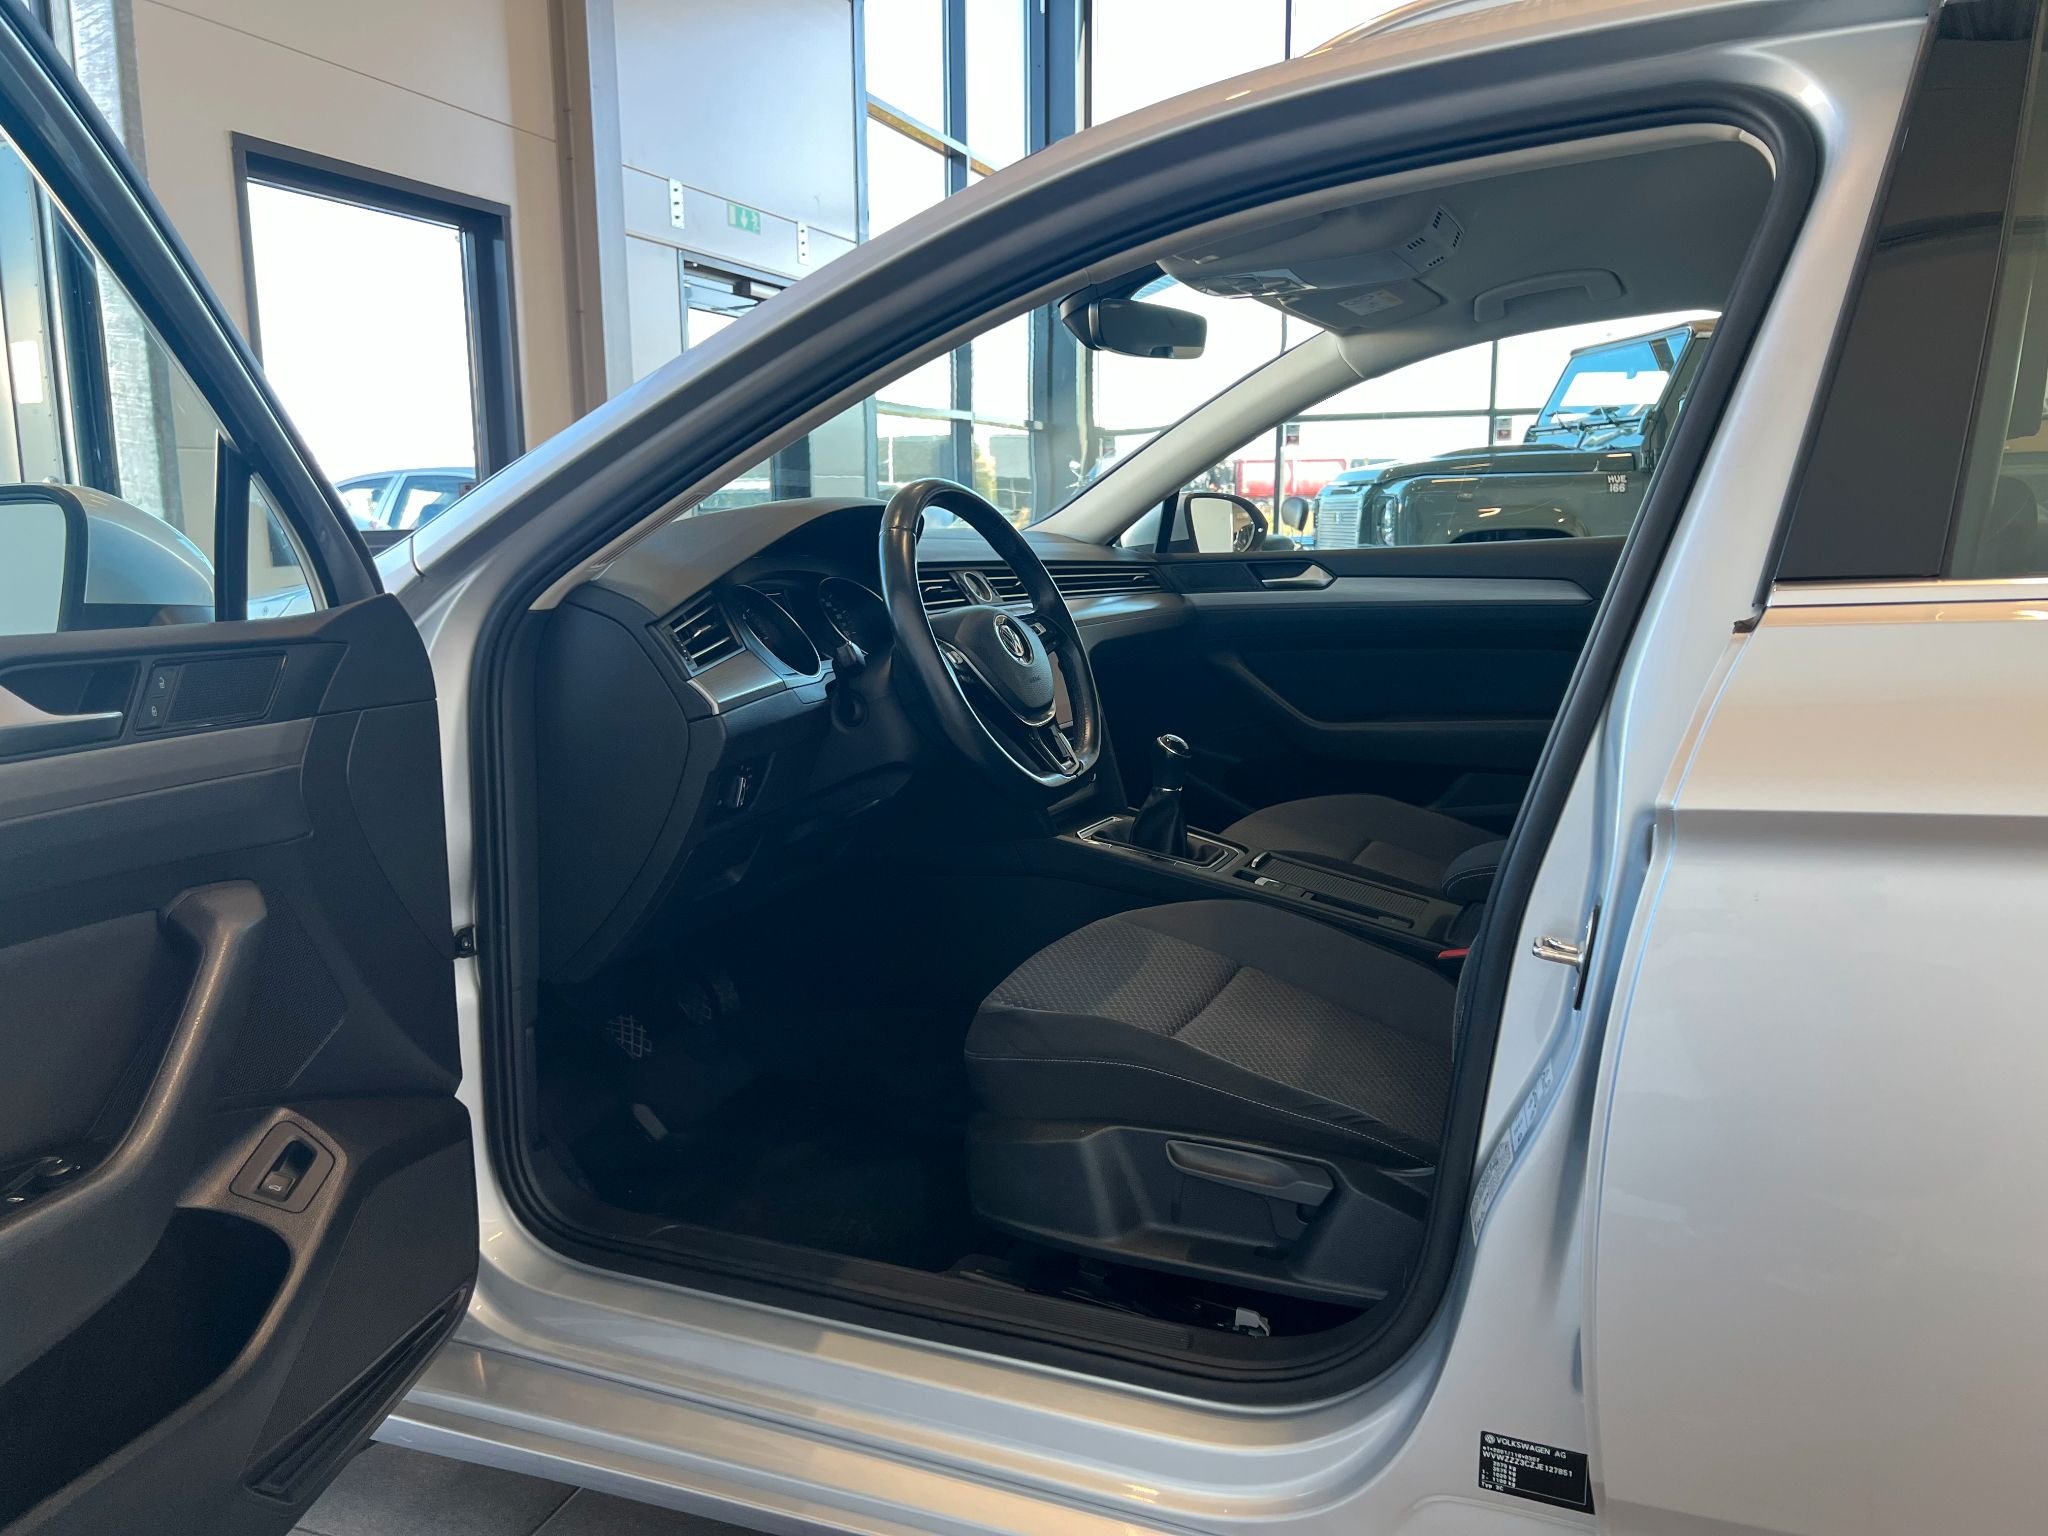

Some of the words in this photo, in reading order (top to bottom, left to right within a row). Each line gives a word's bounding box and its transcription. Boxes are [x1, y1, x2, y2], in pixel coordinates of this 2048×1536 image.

[1607, 474, 1627, 483] HUE
[1609, 483, 1626, 493] 166
[1496, 1437, 1551, 1456] VOLKSWAGEN
[1554, 1450, 1567, 1459] AG
